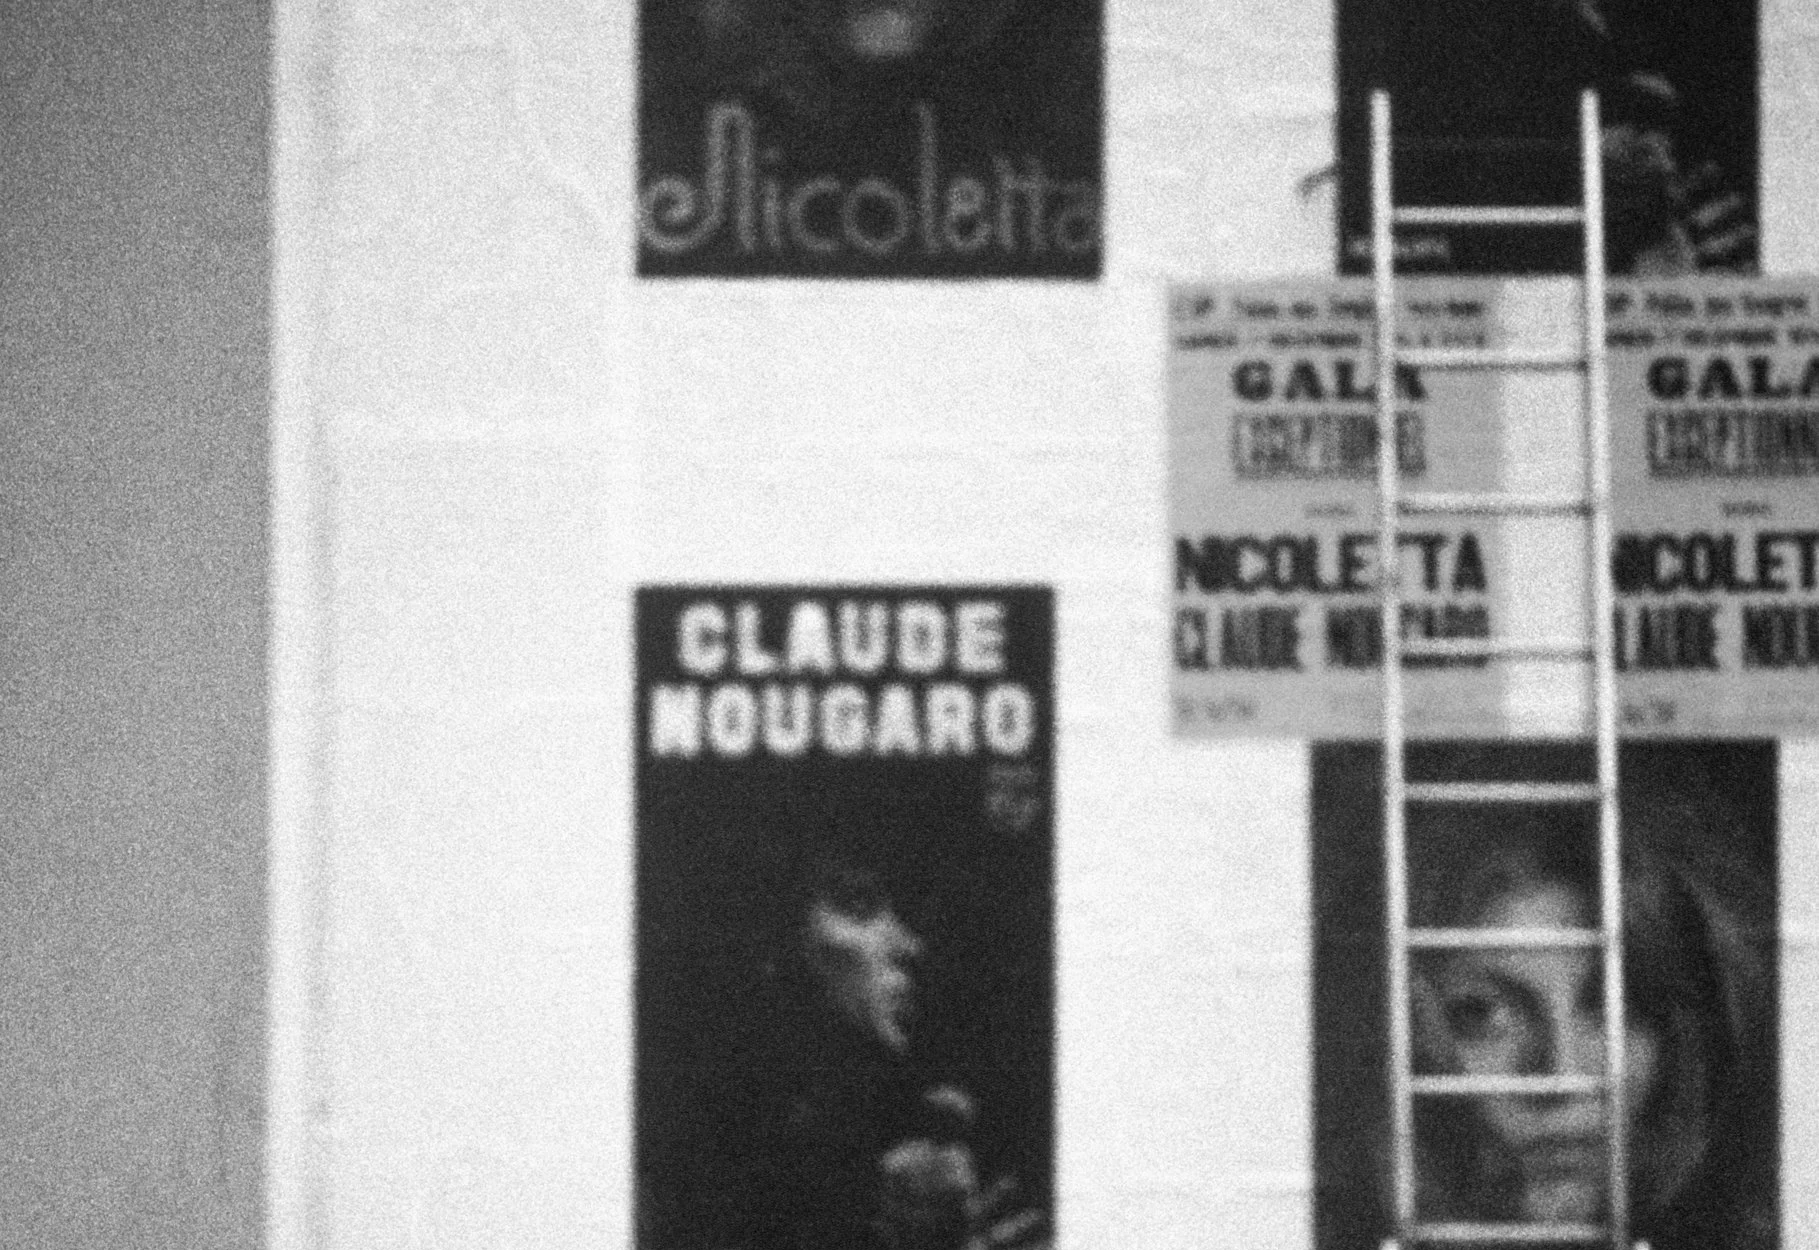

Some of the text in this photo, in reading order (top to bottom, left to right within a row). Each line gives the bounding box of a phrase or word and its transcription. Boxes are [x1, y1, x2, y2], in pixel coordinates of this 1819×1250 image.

[641, 100, 1100, 253] Nicoletta
[1230, 357, 1425, 401] GALA
[678, 600, 1004, 676] CLAUDE
[649, 682, 1036, 758] NOUGARO
